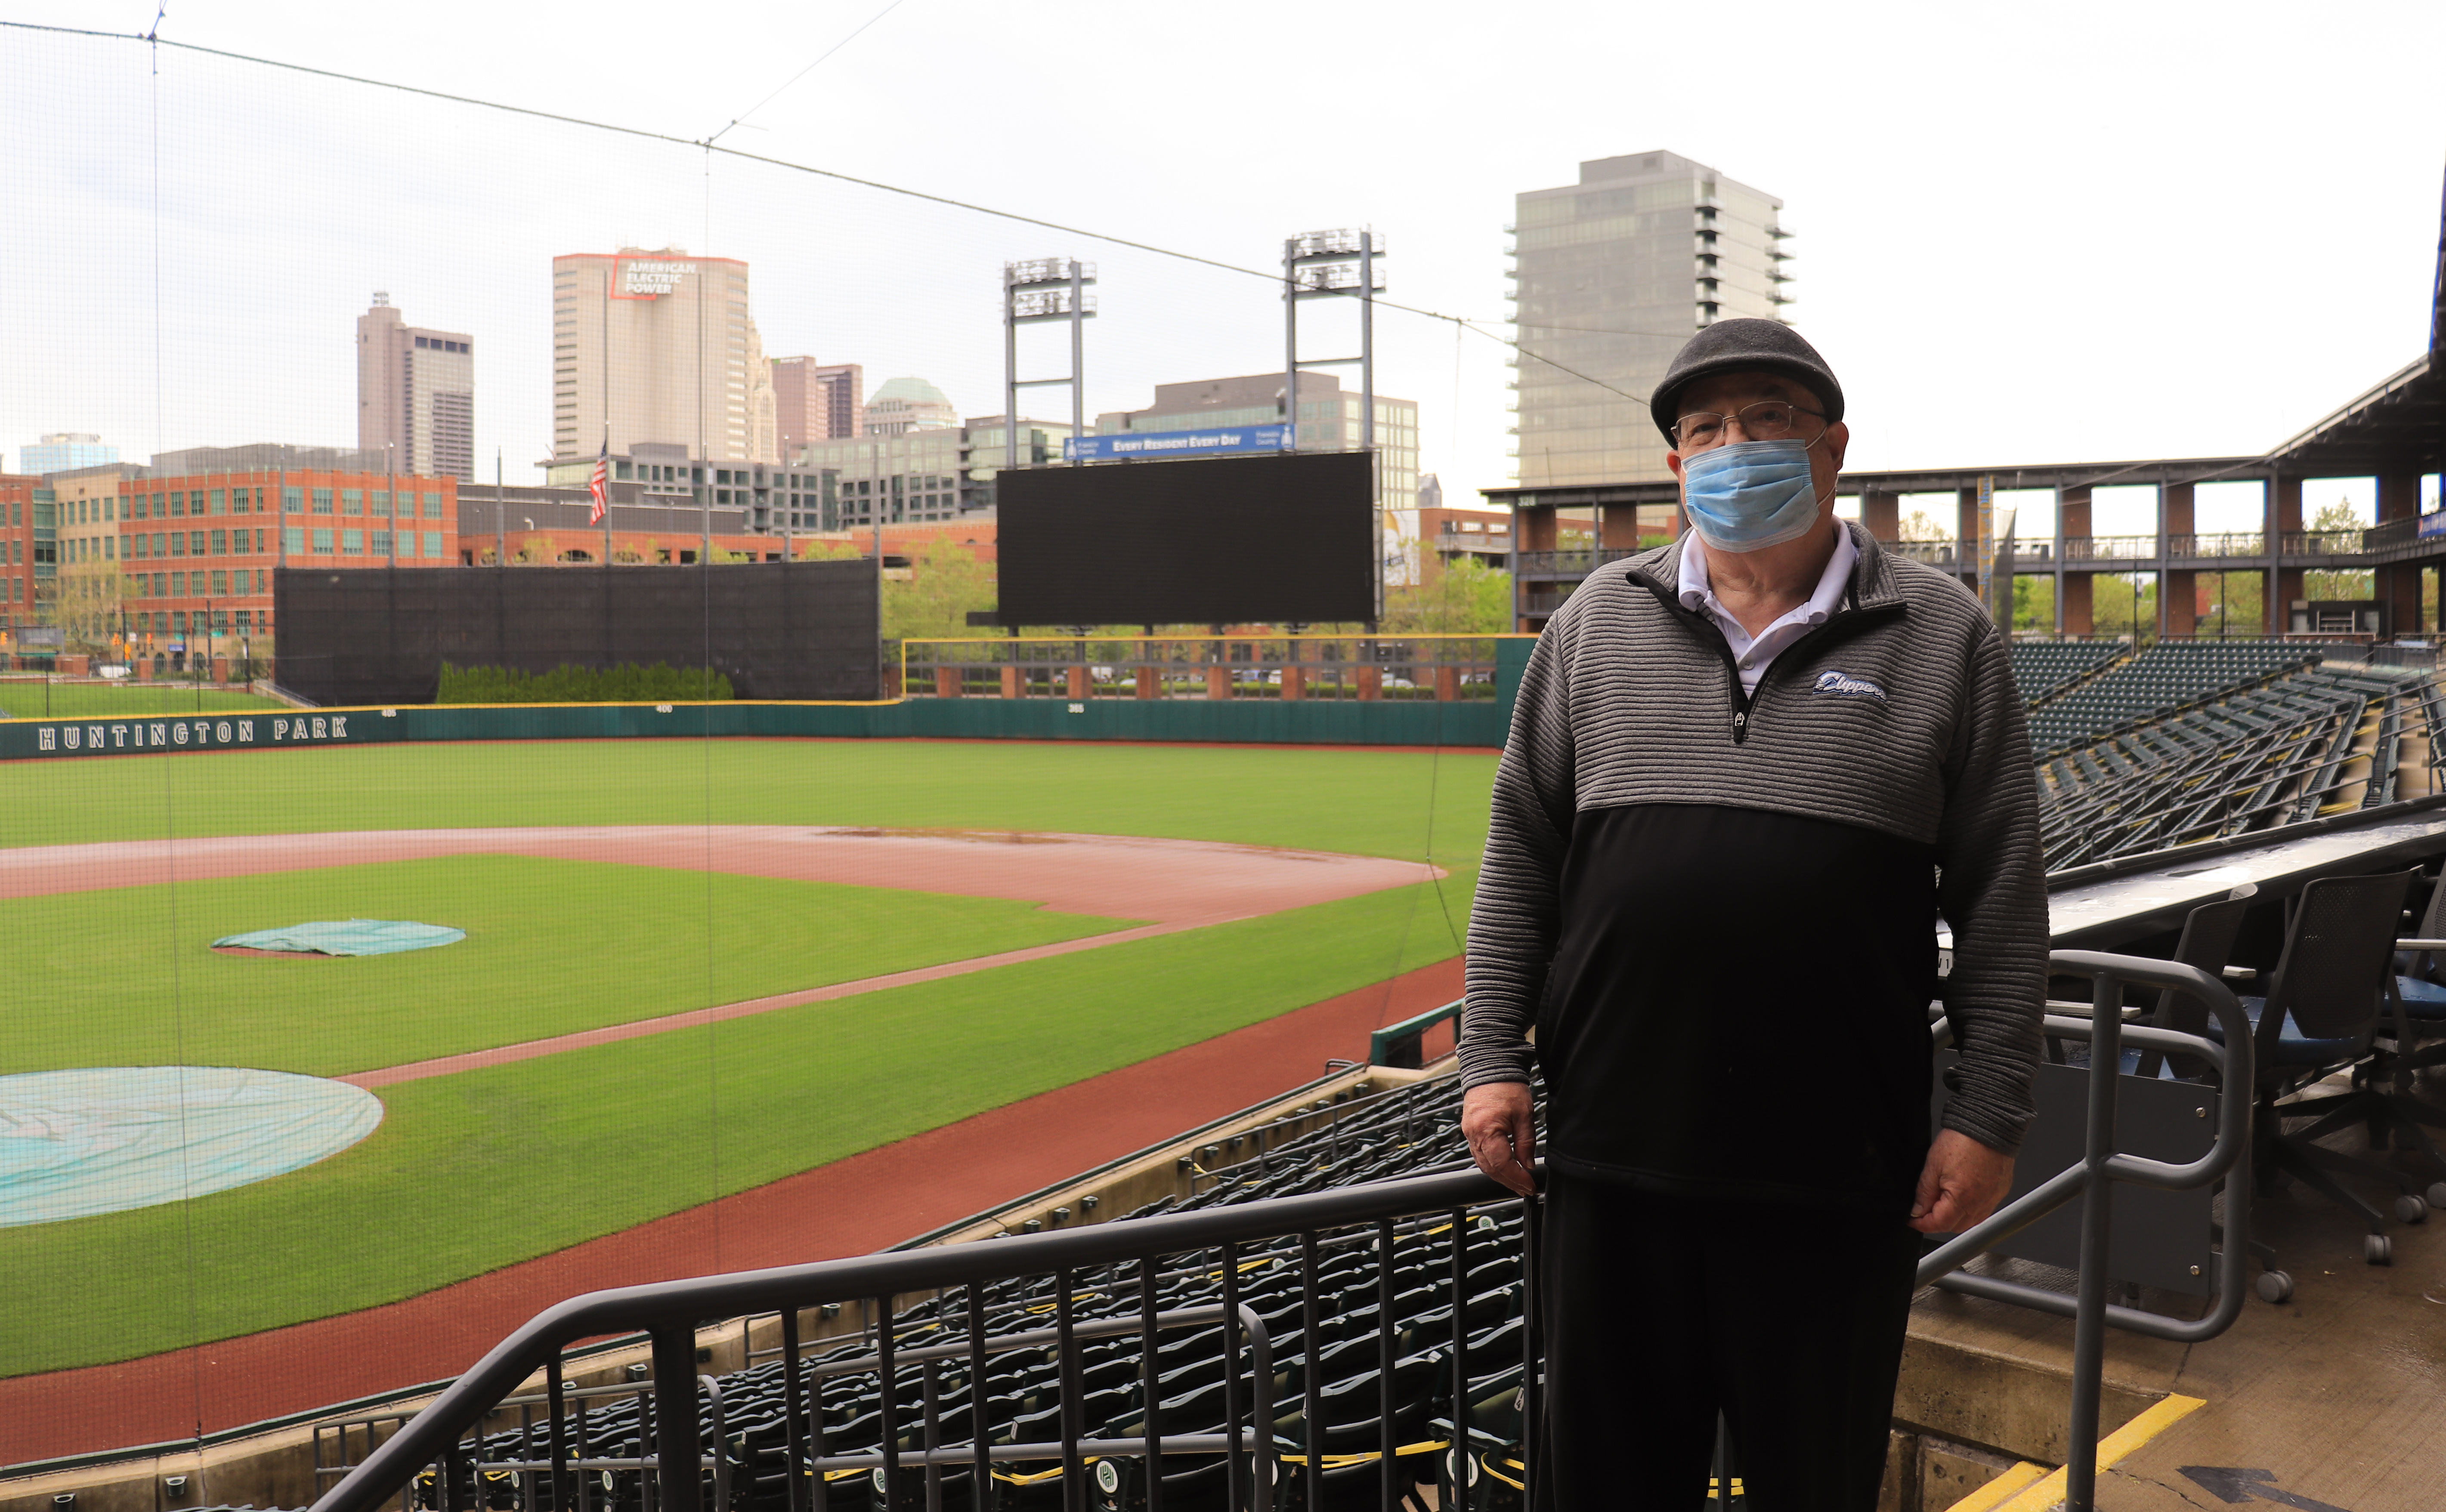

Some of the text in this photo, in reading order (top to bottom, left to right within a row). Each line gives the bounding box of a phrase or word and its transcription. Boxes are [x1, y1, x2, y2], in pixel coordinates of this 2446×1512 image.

[628, 262, 696, 274] AMERICAN
[627, 273, 683, 283] ELECTRIC
[626, 283, 672, 294] POWER
[1220, 434, 1241, 446] DAY
[656, 704, 673, 713] 400
[39, 716, 348, 751] HUNTINGTON PARK
